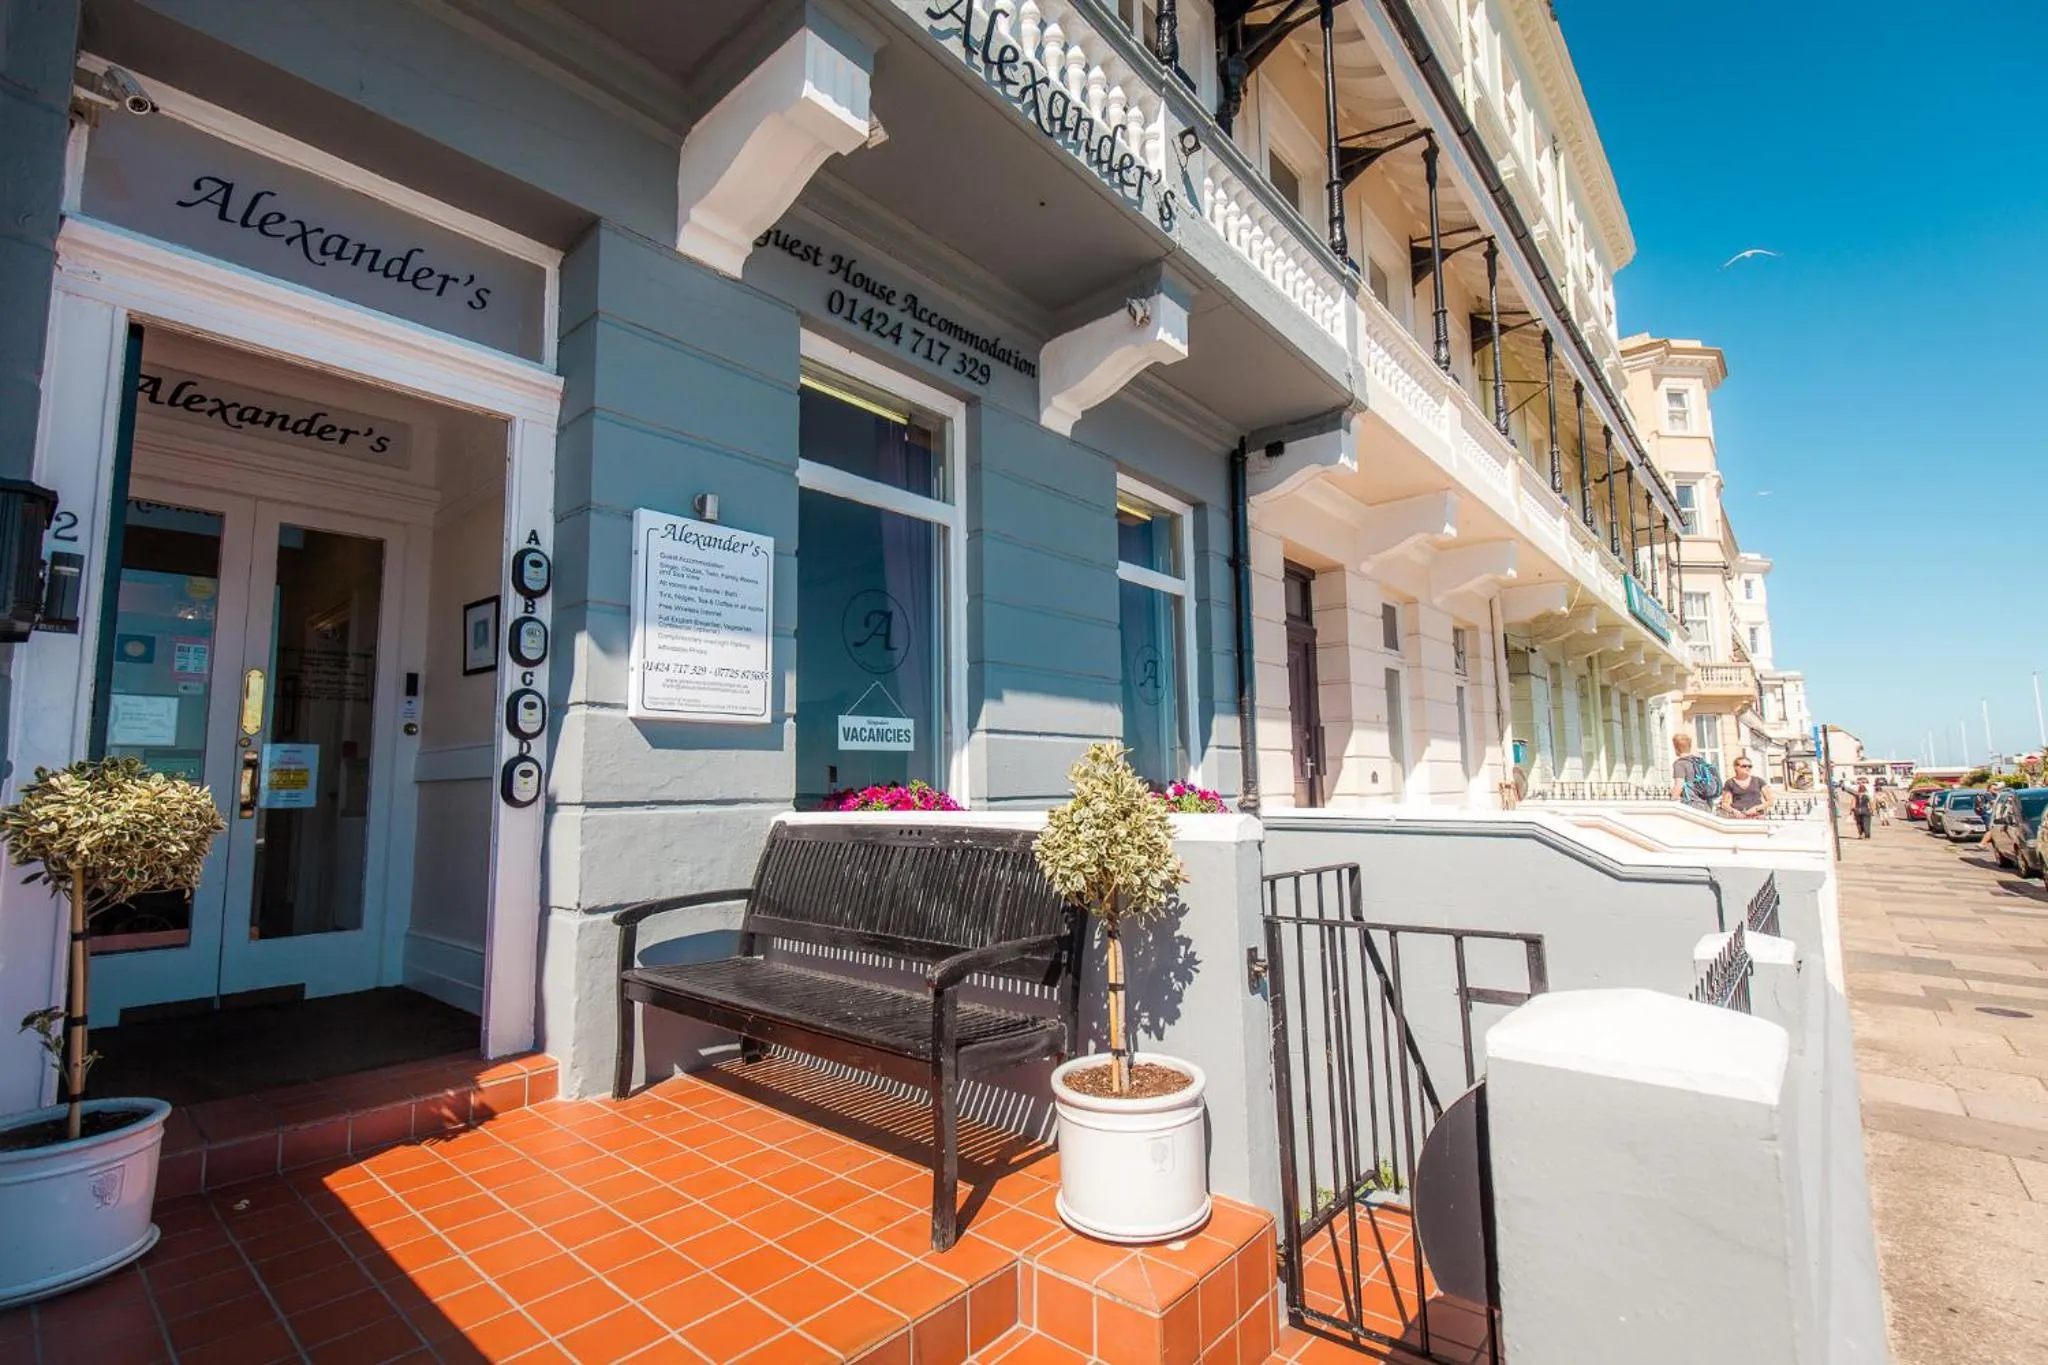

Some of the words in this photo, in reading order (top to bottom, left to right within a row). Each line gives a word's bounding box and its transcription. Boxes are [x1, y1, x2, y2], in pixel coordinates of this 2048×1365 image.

[176, 176, 492, 311] Alexander's
[829, 254, 897, 306] House
[899, 294, 1038, 379] Accommodation
[827, 290, 904, 346] 01424
[910, 327, 952, 367] 717
[953, 353, 992, 386] 329
[525, 529, 541, 546] A
[660, 523, 761, 557] Alexander's
[523, 600, 537, 615] B
[853, 610, 898, 651] A
[521, 671, 534, 686] C
[1139, 660, 1160, 688] A
[842, 727, 912, 743] VACANCIES
